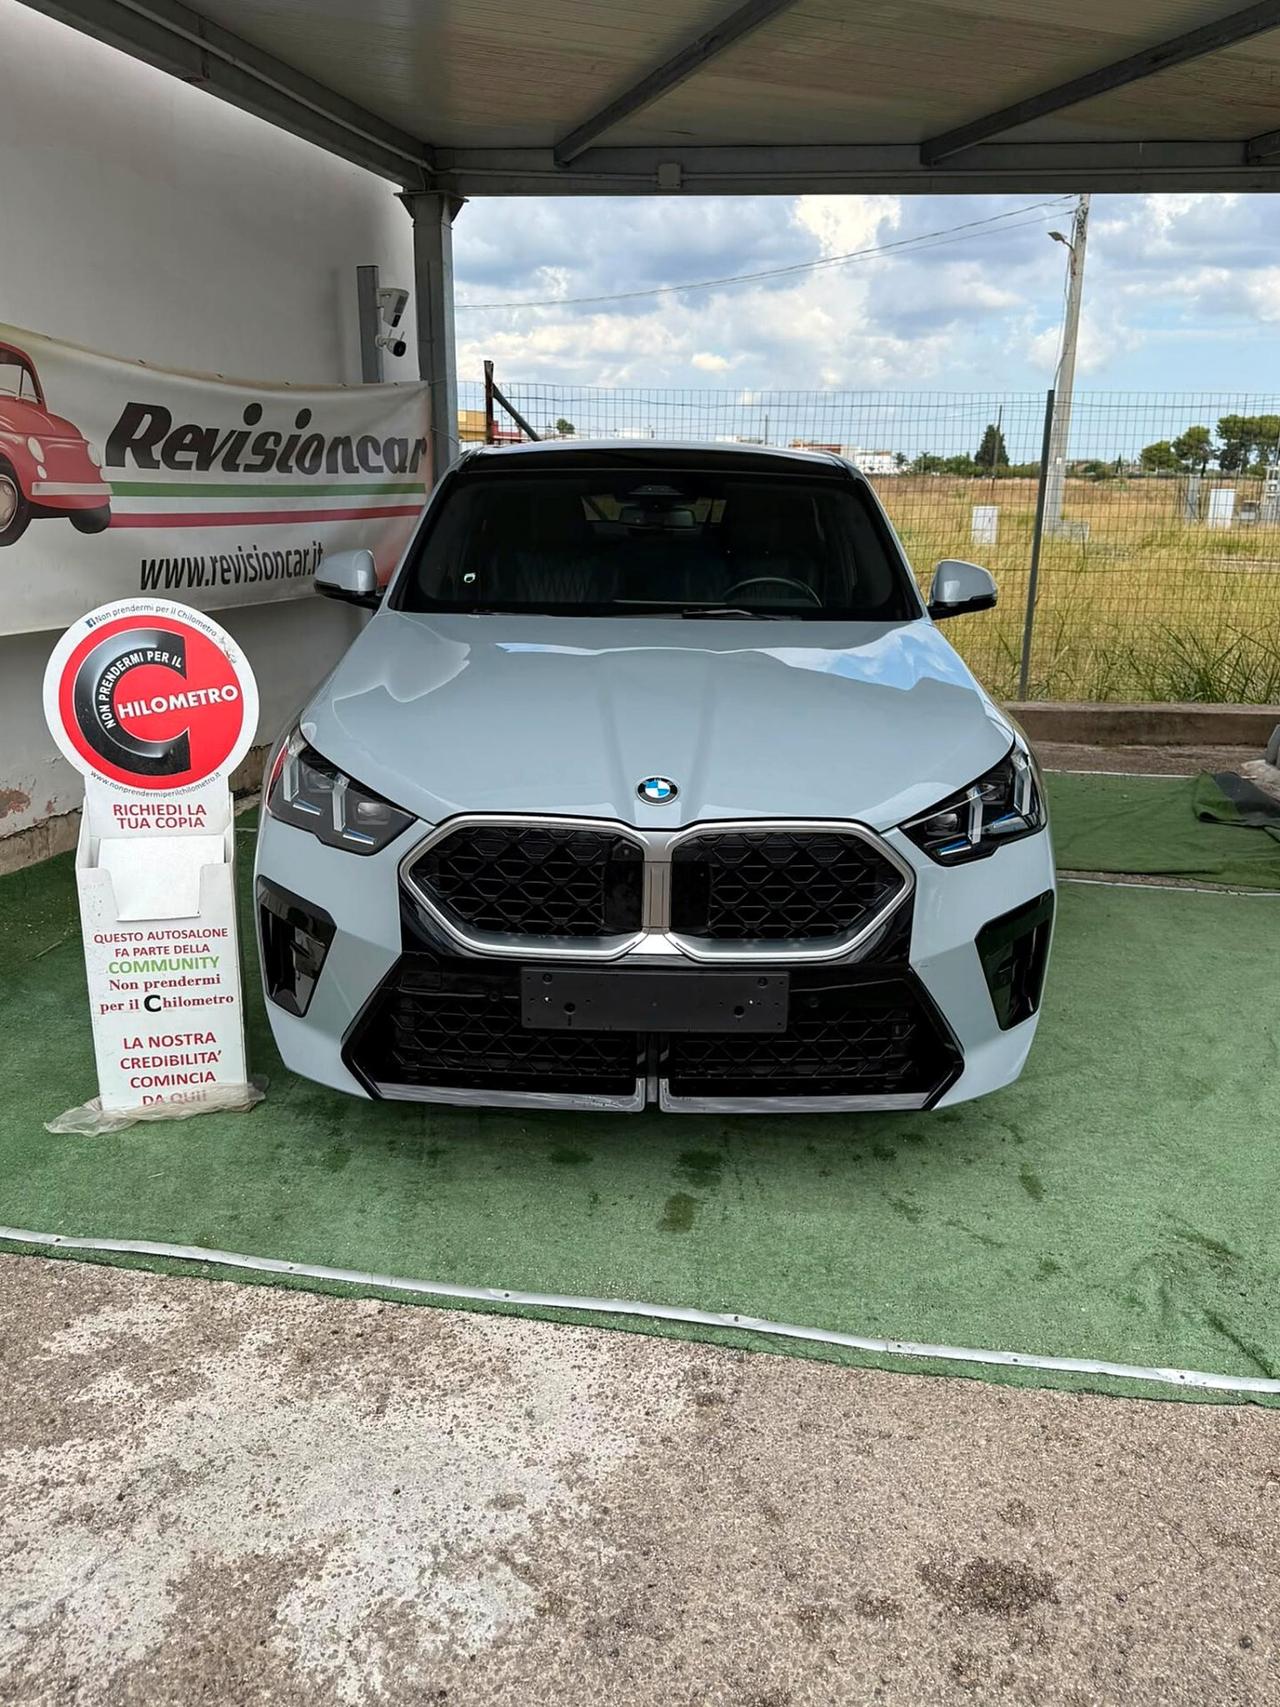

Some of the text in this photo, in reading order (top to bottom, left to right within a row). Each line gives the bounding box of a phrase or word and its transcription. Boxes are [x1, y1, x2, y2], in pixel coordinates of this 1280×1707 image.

[105, 402, 427, 475] Revisioncar
[140, 541, 323, 591] www.revisioncar.it
[95, 612, 112, 624] Non
[112, 604, 154, 617] prendermi
[155, 605, 169, 614] per
[177, 609, 217, 637] Chilometro
[99, 650, 183, 729] NON PRENDERMI PER IL
[113, 804, 207, 816] RICHIEDI LA
[116, 816, 206, 830] TUA COPIA
[94, 928, 228, 944] QUESTO AUTOSALONE
[115, 943, 211, 958] FA PARTE DELLA
[109, 956, 220, 974] COMMUNITY
[109, 973, 221, 992] Non prendermi
[100, 994, 235, 1015] per il Chilometro
[123, 1032, 217, 1050] LA NOSTRA
[120, 1050, 222, 1070] CREDIBILITA'
[130, 1071, 217, 1089] COMINCIA
[142, 1094, 165, 1105] DA
